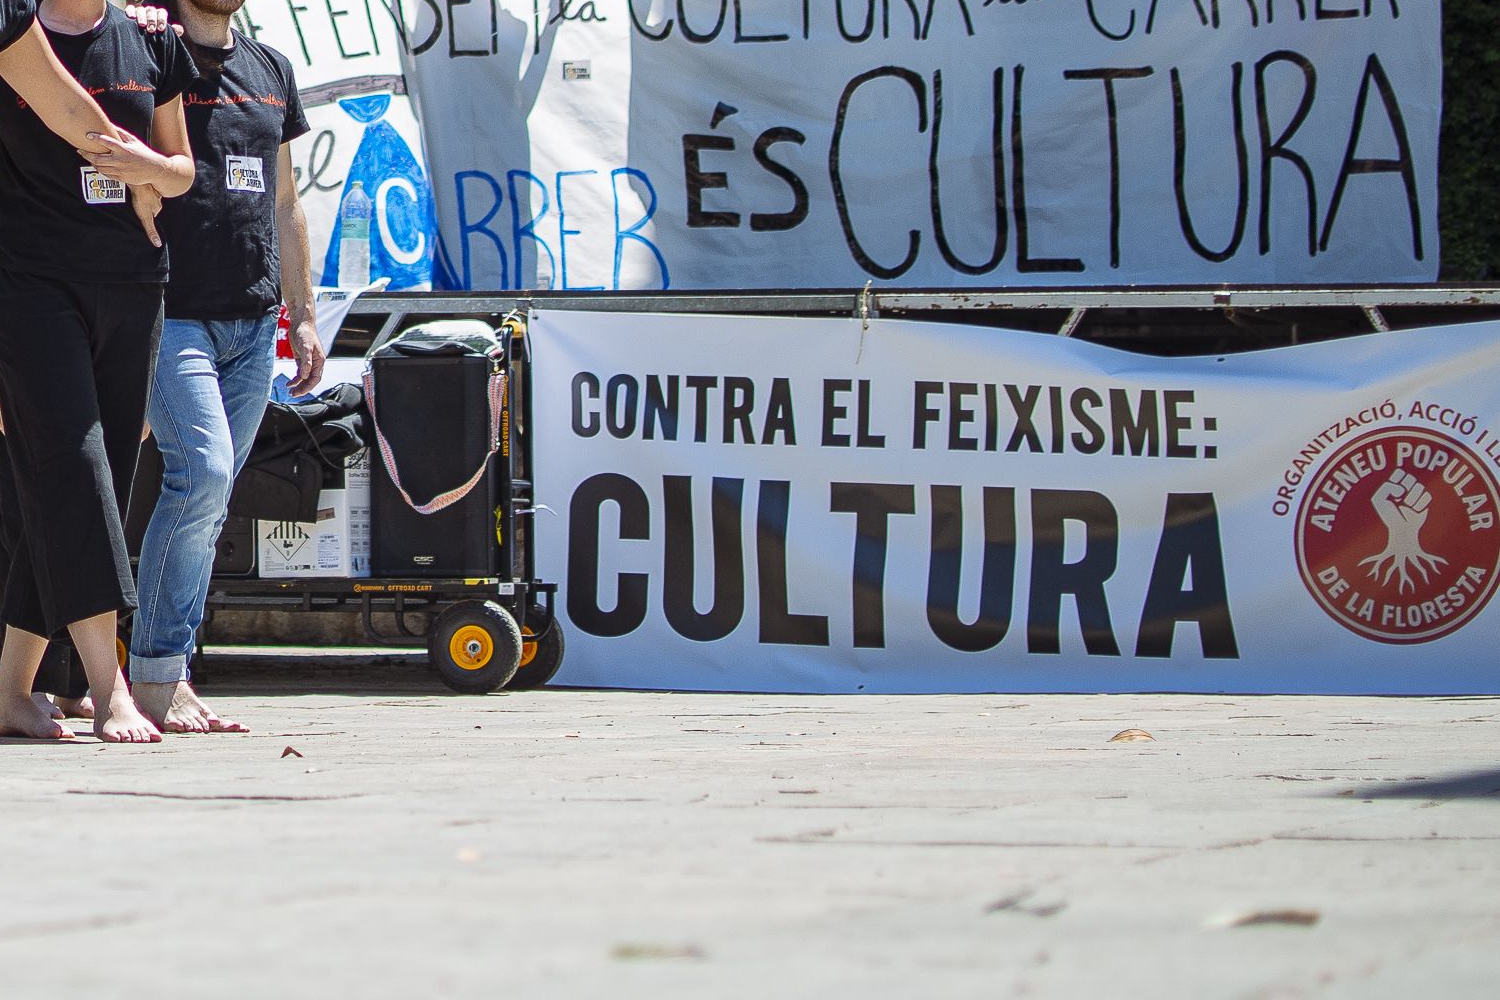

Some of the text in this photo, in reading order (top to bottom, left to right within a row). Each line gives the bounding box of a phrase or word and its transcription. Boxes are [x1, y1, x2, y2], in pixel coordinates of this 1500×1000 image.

[682, 101, 809, 232] ÉS
[828, 49, 1425, 279] CULTURA
[571, 371, 1219, 459] CONTRA EL FEIXISME:
[1272, 399, 1403, 517] ORGANITZACIÓ,
[1409, 401, 1478, 436] ACCIÓ
[1310, 442, 1494, 534] ATENEU POPULAR
[387, 584, 416, 592] OFFROAD
[416, 584, 433, 592] CART
[567, 472, 1240, 660] CULTURA
[1317, 565, 1487, 628] DE LA FLORESTA
